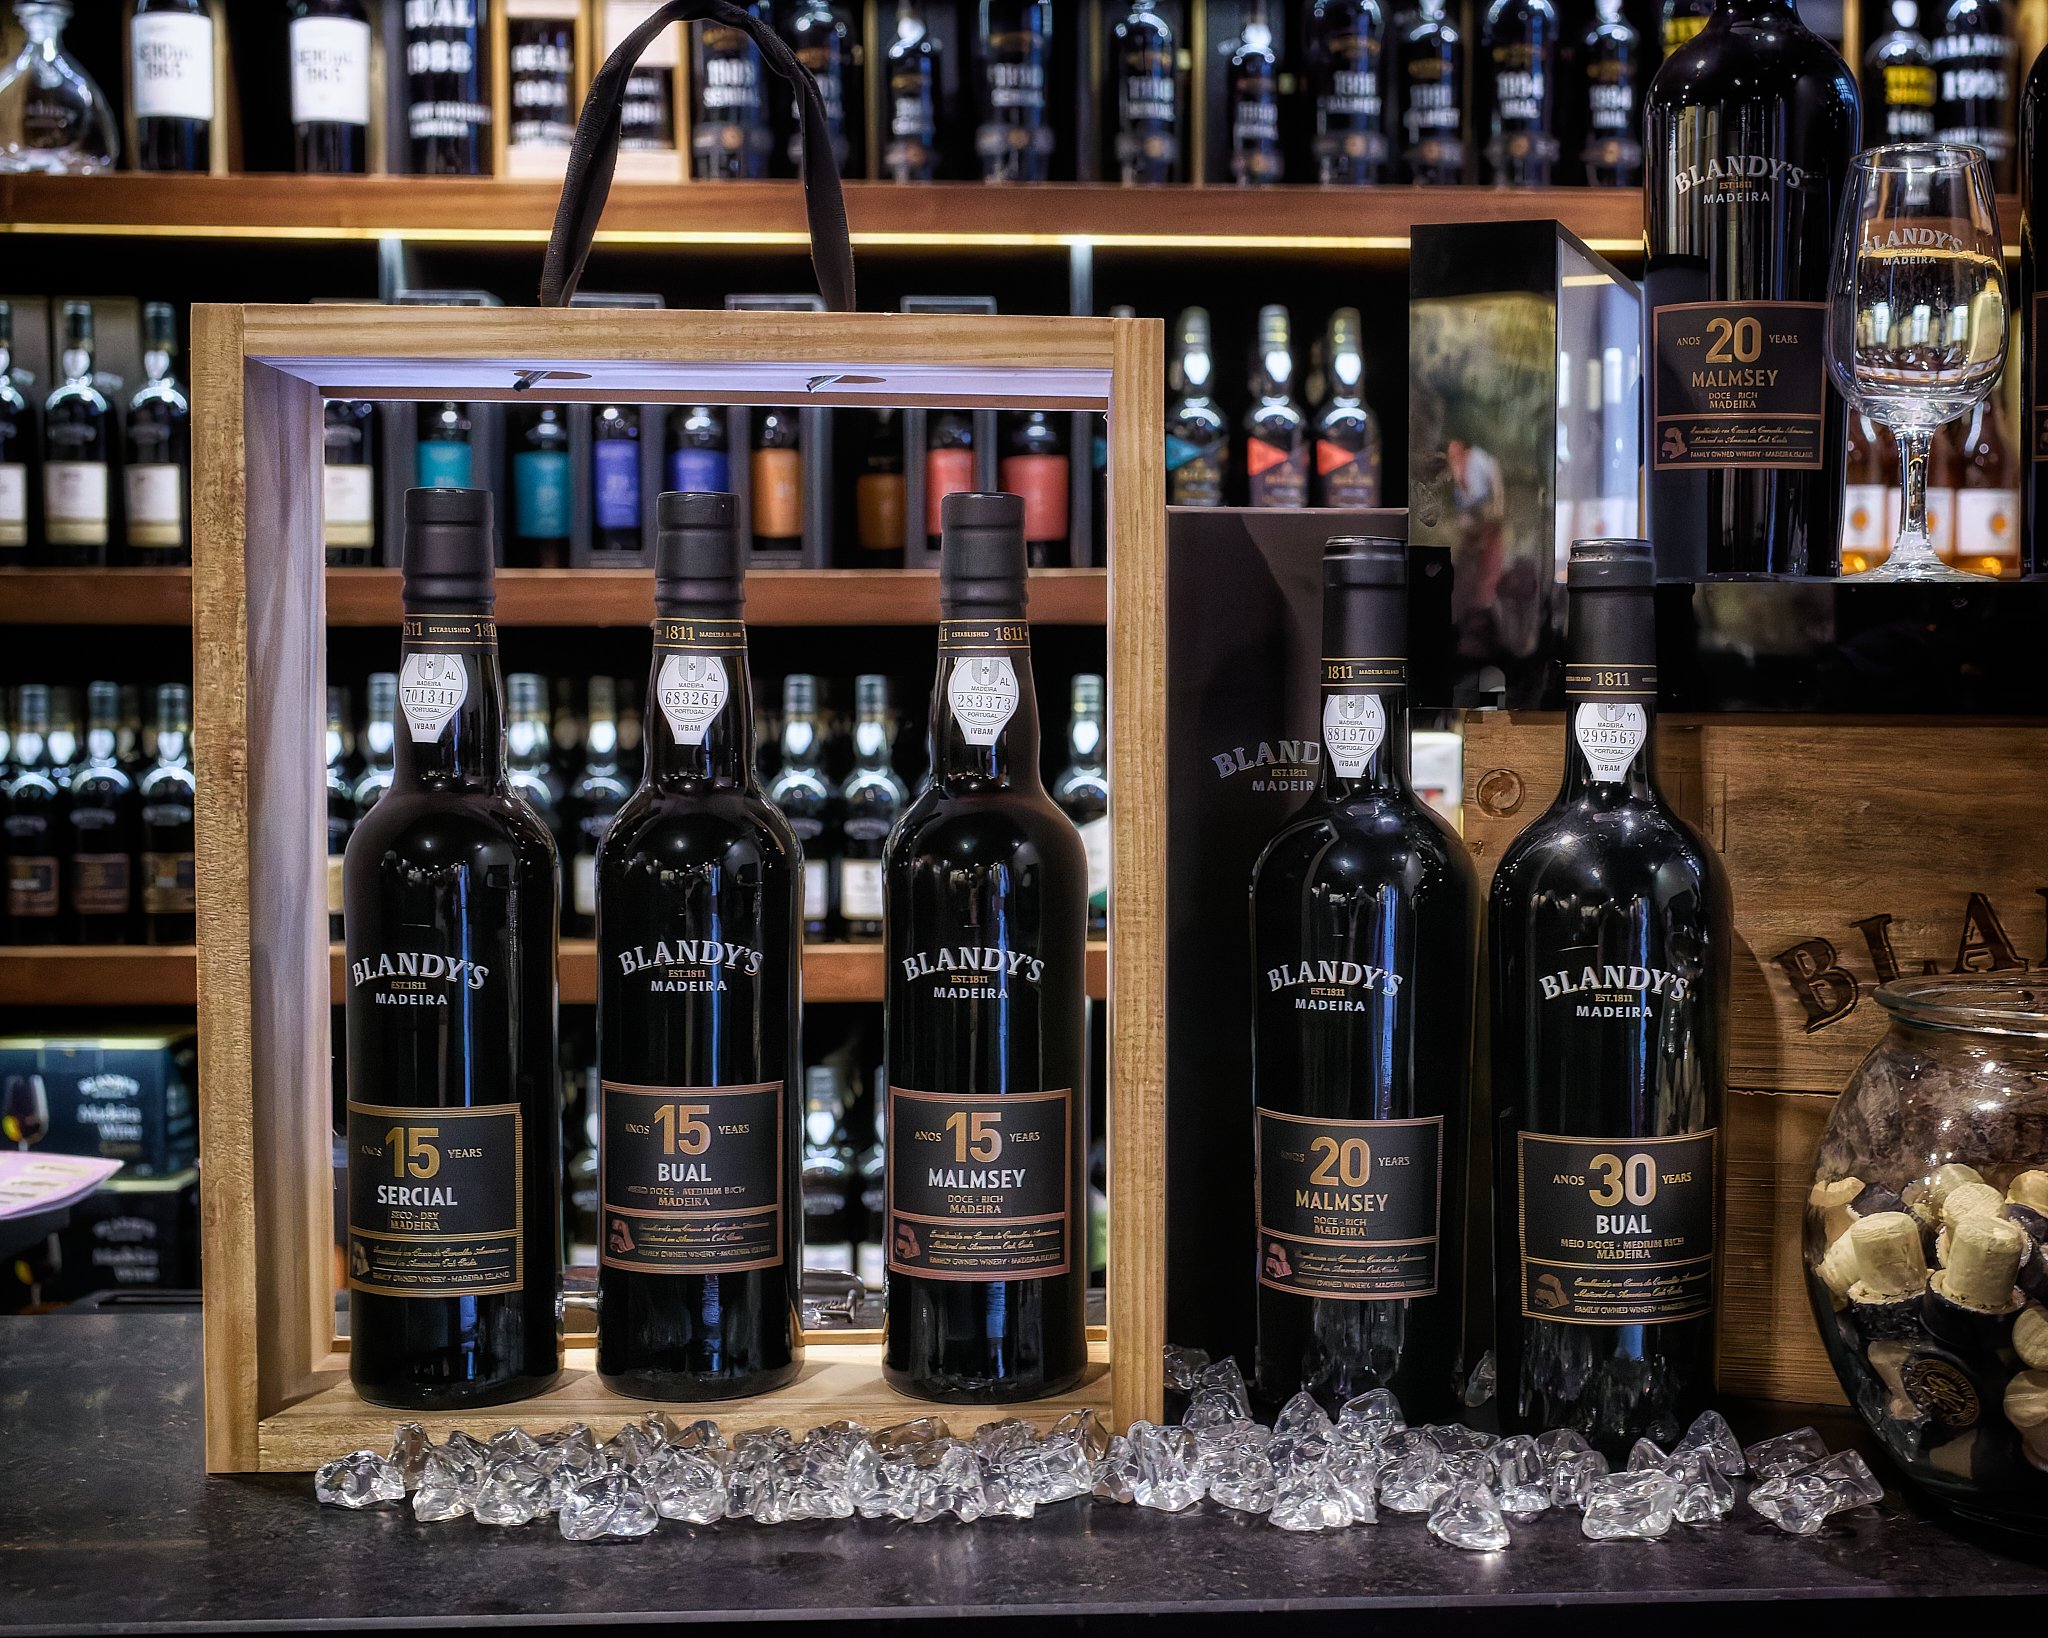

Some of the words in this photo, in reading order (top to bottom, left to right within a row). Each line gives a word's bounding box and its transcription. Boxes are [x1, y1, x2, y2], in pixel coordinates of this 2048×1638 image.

[1675, 155, 1804, 194] BLANDY'S
[1704, 192, 1770, 204] MADEIRA
[1860, 228, 1962, 258] BLANDY'S
[1882, 256, 1936, 266] MADEIRA
[1676, 336, 1701, 346] ANOS
[1705, 316, 1762, 364] 20
[1769, 334, 1798, 344] YEARS
[1692, 369, 1779, 388] MALMSEY
[1708, 392, 1731, 400] DOCE
[1709, 400, 1756, 408] MADEIRA
[666, 626, 696, 640] 1811
[994, 626, 1024, 641] 1811
[444, 671, 456, 680] AL
[707, 673, 718, 682] AL
[1328, 665, 1354, 680] 1811
[1596, 672, 1630, 686] 1811
[1000, 678, 1010, 686] AL
[405, 690, 455, 705] 701341
[665, 691, 718, 706] 683264
[958, 694, 1012, 710] 283373
[1366, 710, 1375, 718] V1
[414, 722, 436, 730] IVBAM
[678, 724, 700, 732] IVBAM
[1328, 728, 1375, 742] 881970
[1582, 730, 1636, 744] 299563
[1212, 740, 1320, 779] BLAND
[1338, 760, 1360, 768] IVBAM
[1597, 764, 1620, 772] IVBAM
[1252, 780, 1315, 791] MADEIR
[618, 940, 764, 976] BLANDY'S
[902, 946, 1045, 982] BLANDY'S
[1771, 888, 2048, 1033] BLA
[352, 952, 490, 990] BLANDY'S
[1266, 960, 1404, 997] BLANDY'S
[1538, 965, 1690, 1002] BLANDY'S
[650, 980, 728, 992] MADEIRA
[934, 987, 1008, 998] MADEIRA
[376, 993, 448, 1005] MADEIRA
[1295, 998, 1366, 1012] MADEIRA
[1576, 1006, 1653, 1018] MADEIRA
[654, 1104, 712, 1156] 15
[718, 1124, 750, 1135] YEARS
[914, 1132, 942, 1142] ANOS
[946, 1112, 1003, 1163] 15
[1010, 1132, 1040, 1143] YEARS
[384, 1126, 440, 1179] 15
[448, 1148, 483, 1158] YEARS
[1309, 1136, 1372, 1187] 20
[1378, 1156, 1410, 1167] YEARS
[658, 1164, 712, 1182] BUAL
[928, 1168, 1026, 1189] MALMSEY
[1552, 1174, 1585, 1186] ANOS
[1588, 1154, 1657, 1206] 30
[1662, 1172, 1692, 1184] YEARS
[377, 1185, 458, 1206] SERCIAL
[658, 1198, 710, 1207] MADEIRA
[948, 1194, 974, 1203] DOCE
[981, 1195, 1004, 1203] RICH
[1295, 1189, 1389, 1212] MALMSEY
[950, 1204, 1002, 1214] MADEIRA
[390, 1220, 440, 1230] MADEIRA
[1314, 1216, 1338, 1225] DOCE
[1345, 1218, 1367, 1226] RICH
[1596, 1214, 1652, 1235] BUAL
[1314, 1226, 1366, 1236] MADEIRA
[1586, 1240, 1614, 1249] DOCE
[1596, 1250, 1651, 1260] MADEIRA
